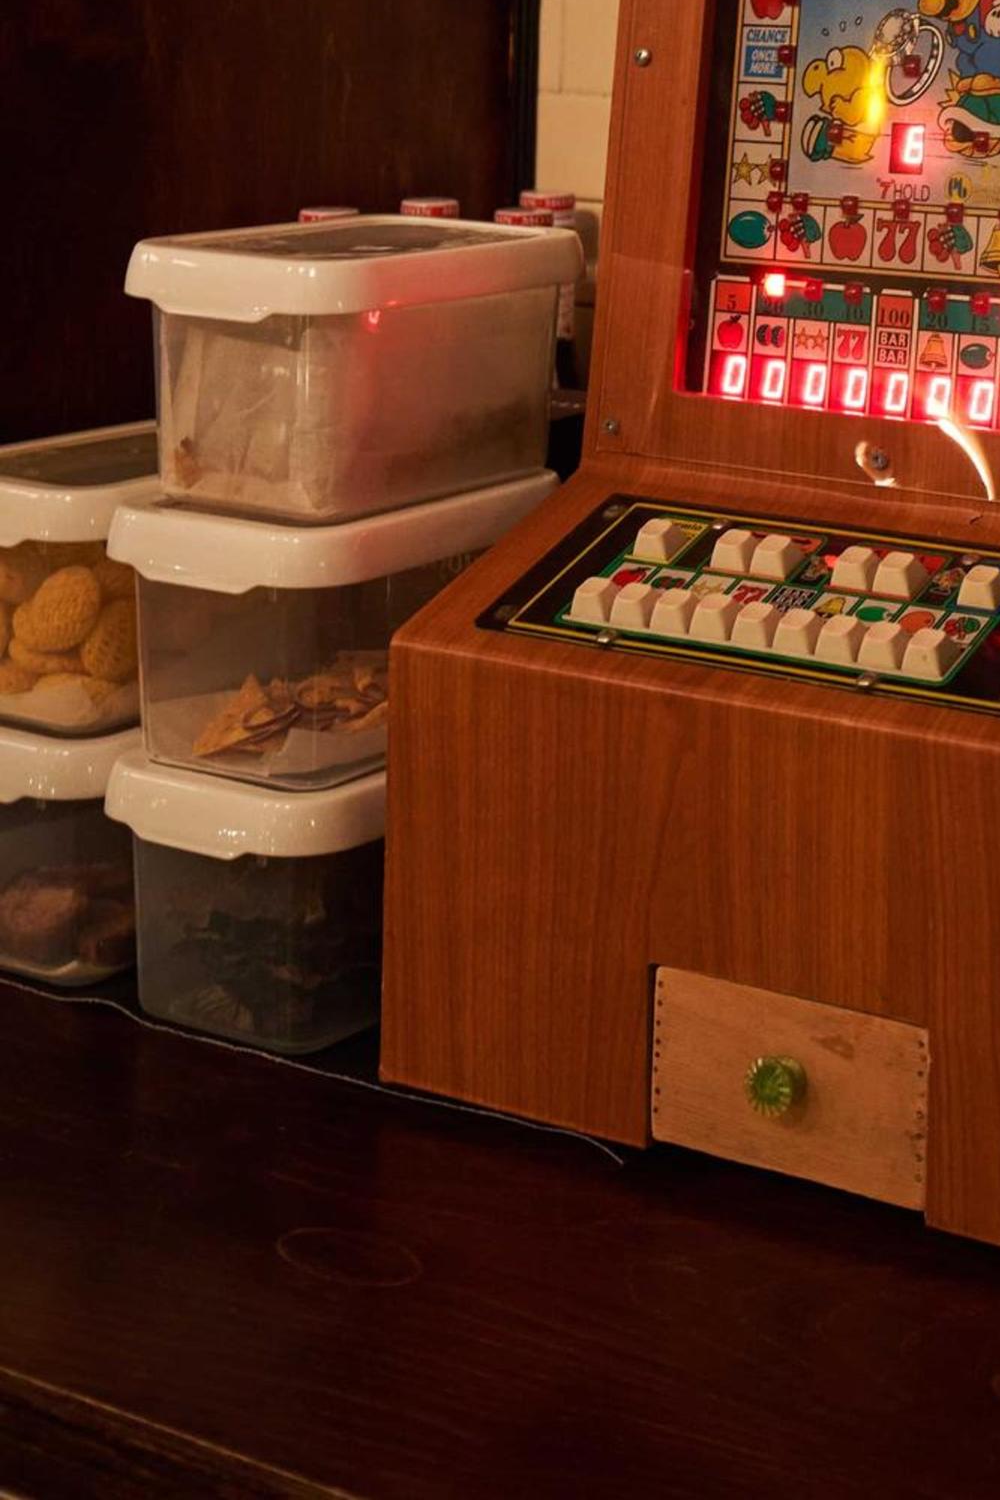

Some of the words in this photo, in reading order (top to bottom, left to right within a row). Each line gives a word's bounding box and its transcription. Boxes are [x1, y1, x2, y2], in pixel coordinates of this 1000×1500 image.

[747, 28, 788, 43] CHANCE
[893, 183, 931, 202] HOLD
[879, 308, 911, 326] 100
[880, 331, 908, 347] BAR
[878, 349, 906, 365] BAR
[722, 355, 747, 394] 0
[762, 360, 786, 399] 0
[803, 364, 827, 404] 0
[844, 368, 868, 408] 0
[884, 372, 909, 411] 0
[968, 380, 994, 421] 0
